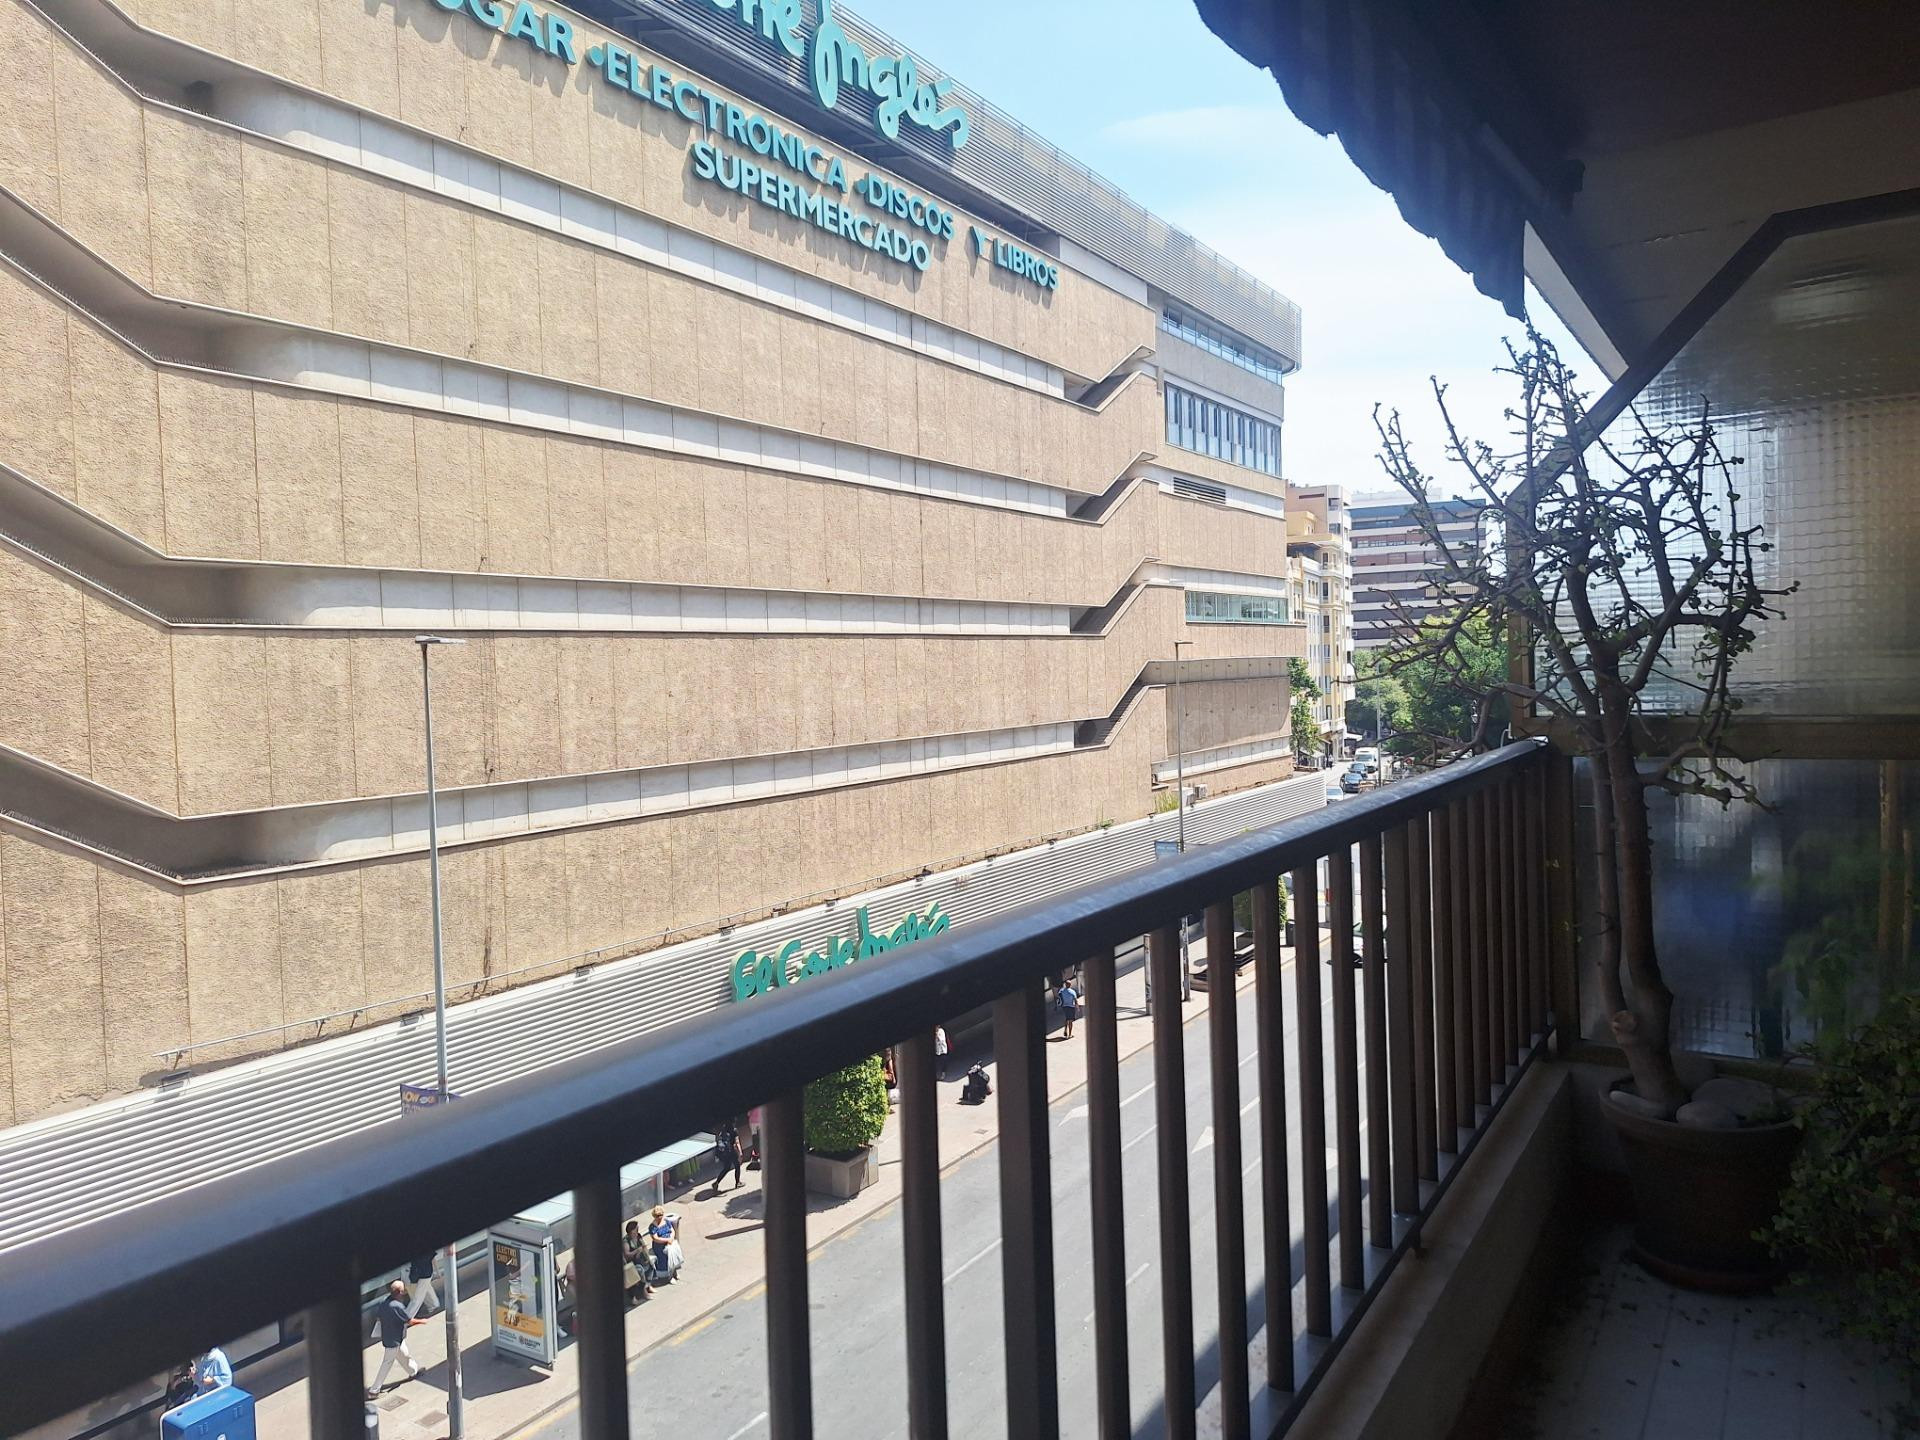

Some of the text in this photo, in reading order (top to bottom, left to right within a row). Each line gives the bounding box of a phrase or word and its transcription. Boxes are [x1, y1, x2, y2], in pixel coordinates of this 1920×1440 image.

[430, 0, 1060, 290] GAR ELECTRONICA DISCOS Y LIBROS
[691, 140, 931, 272] SUPERMERCADO
[732, 950, 773, 1001] El
